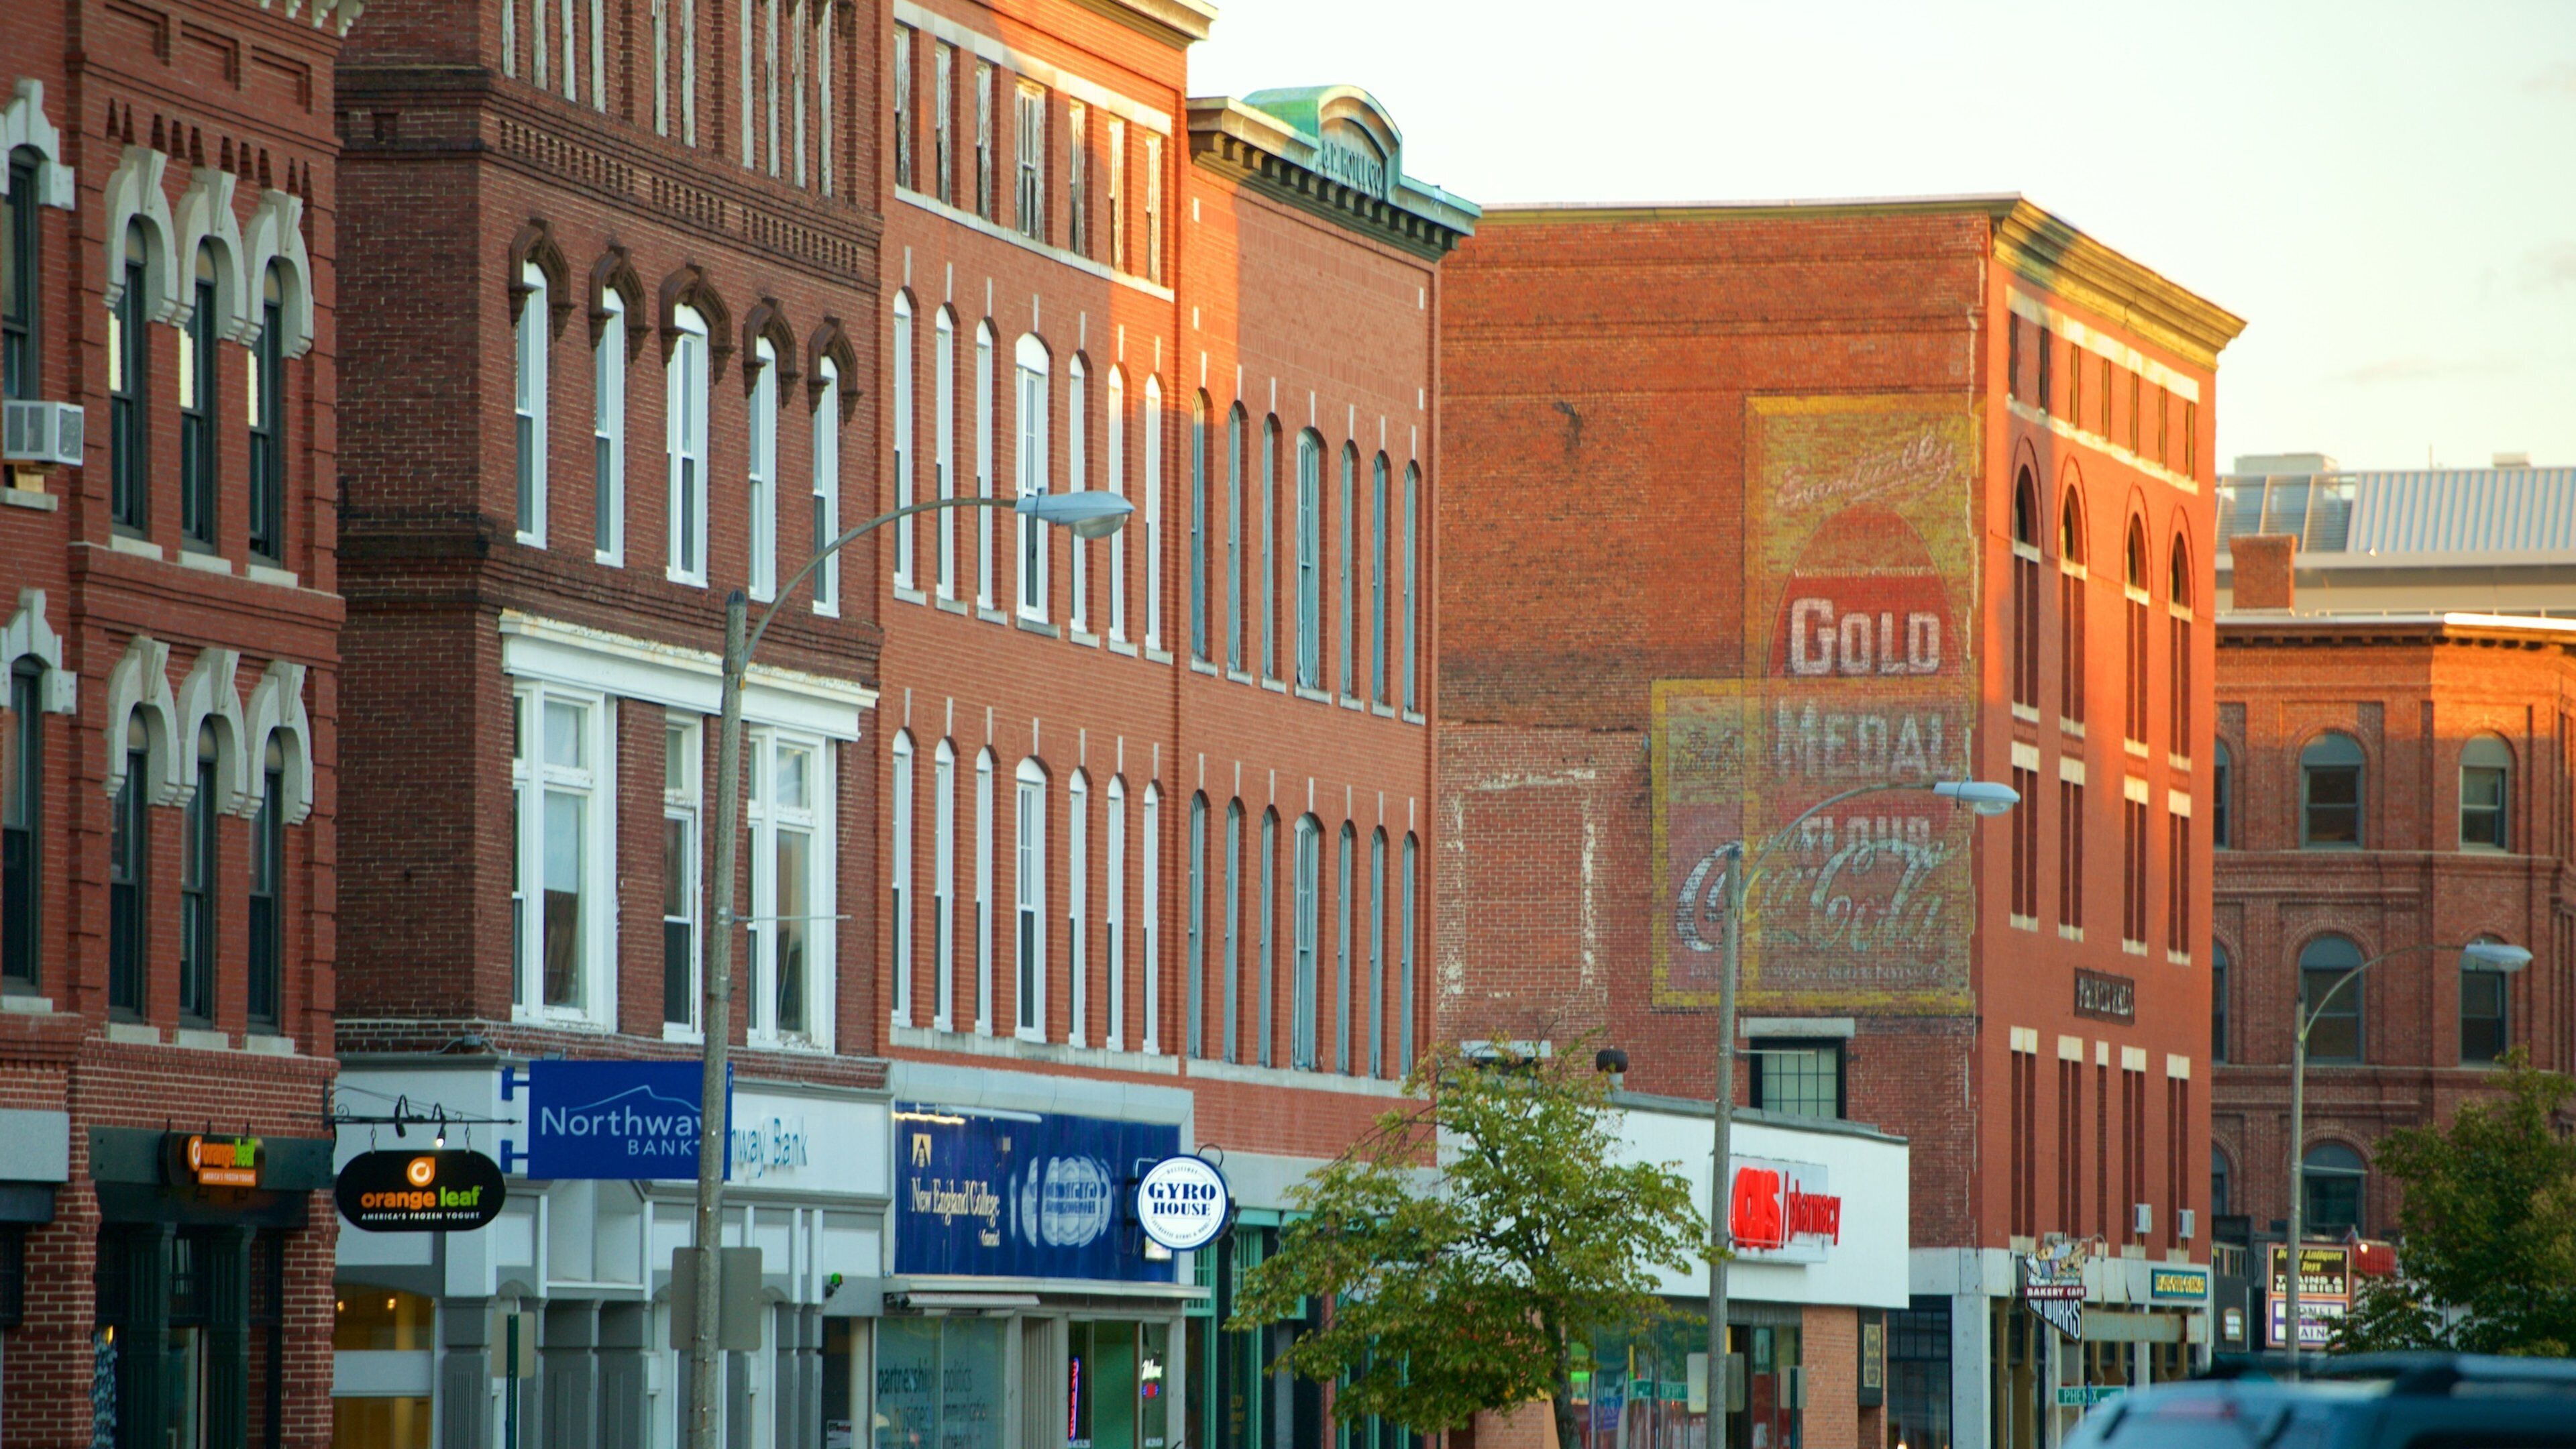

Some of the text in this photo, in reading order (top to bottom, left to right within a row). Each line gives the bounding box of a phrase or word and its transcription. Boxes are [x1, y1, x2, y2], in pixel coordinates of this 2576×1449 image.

[1790, 597, 1941, 676] GOLD
[1775, 698, 1951, 778] MEDAL
[1801, 816, 1931, 855] FLOUR
[541, 1105, 701, 1136] Northwa
[202, 1137, 255, 1169] orange leaf
[627, 1140, 692, 1156] BANK
[774, 1116, 808, 1167] Bank
[361, 1185, 480, 1210] orange leaf
[911, 1177, 932, 1213] New
[932, 1178, 969, 1226] England
[969, 1180, 1000, 1228] College
[1148, 1183, 1216, 1200] GYRO
[361, 1212, 407, 1220] AMERICA'S
[410, 1212, 443, 1220] FROZEN
[1153, 1201, 1211, 1216] HOUSE
[2027, 1287, 2064, 1297] BAKERY
[2275, 1274, 2328, 1285] TAINS
[2275, 1283, 2344, 1293] HBBIES
[2029, 1299, 2081, 1339] THE WORKS
[2063, 1388, 2098, 1403] PHENX
